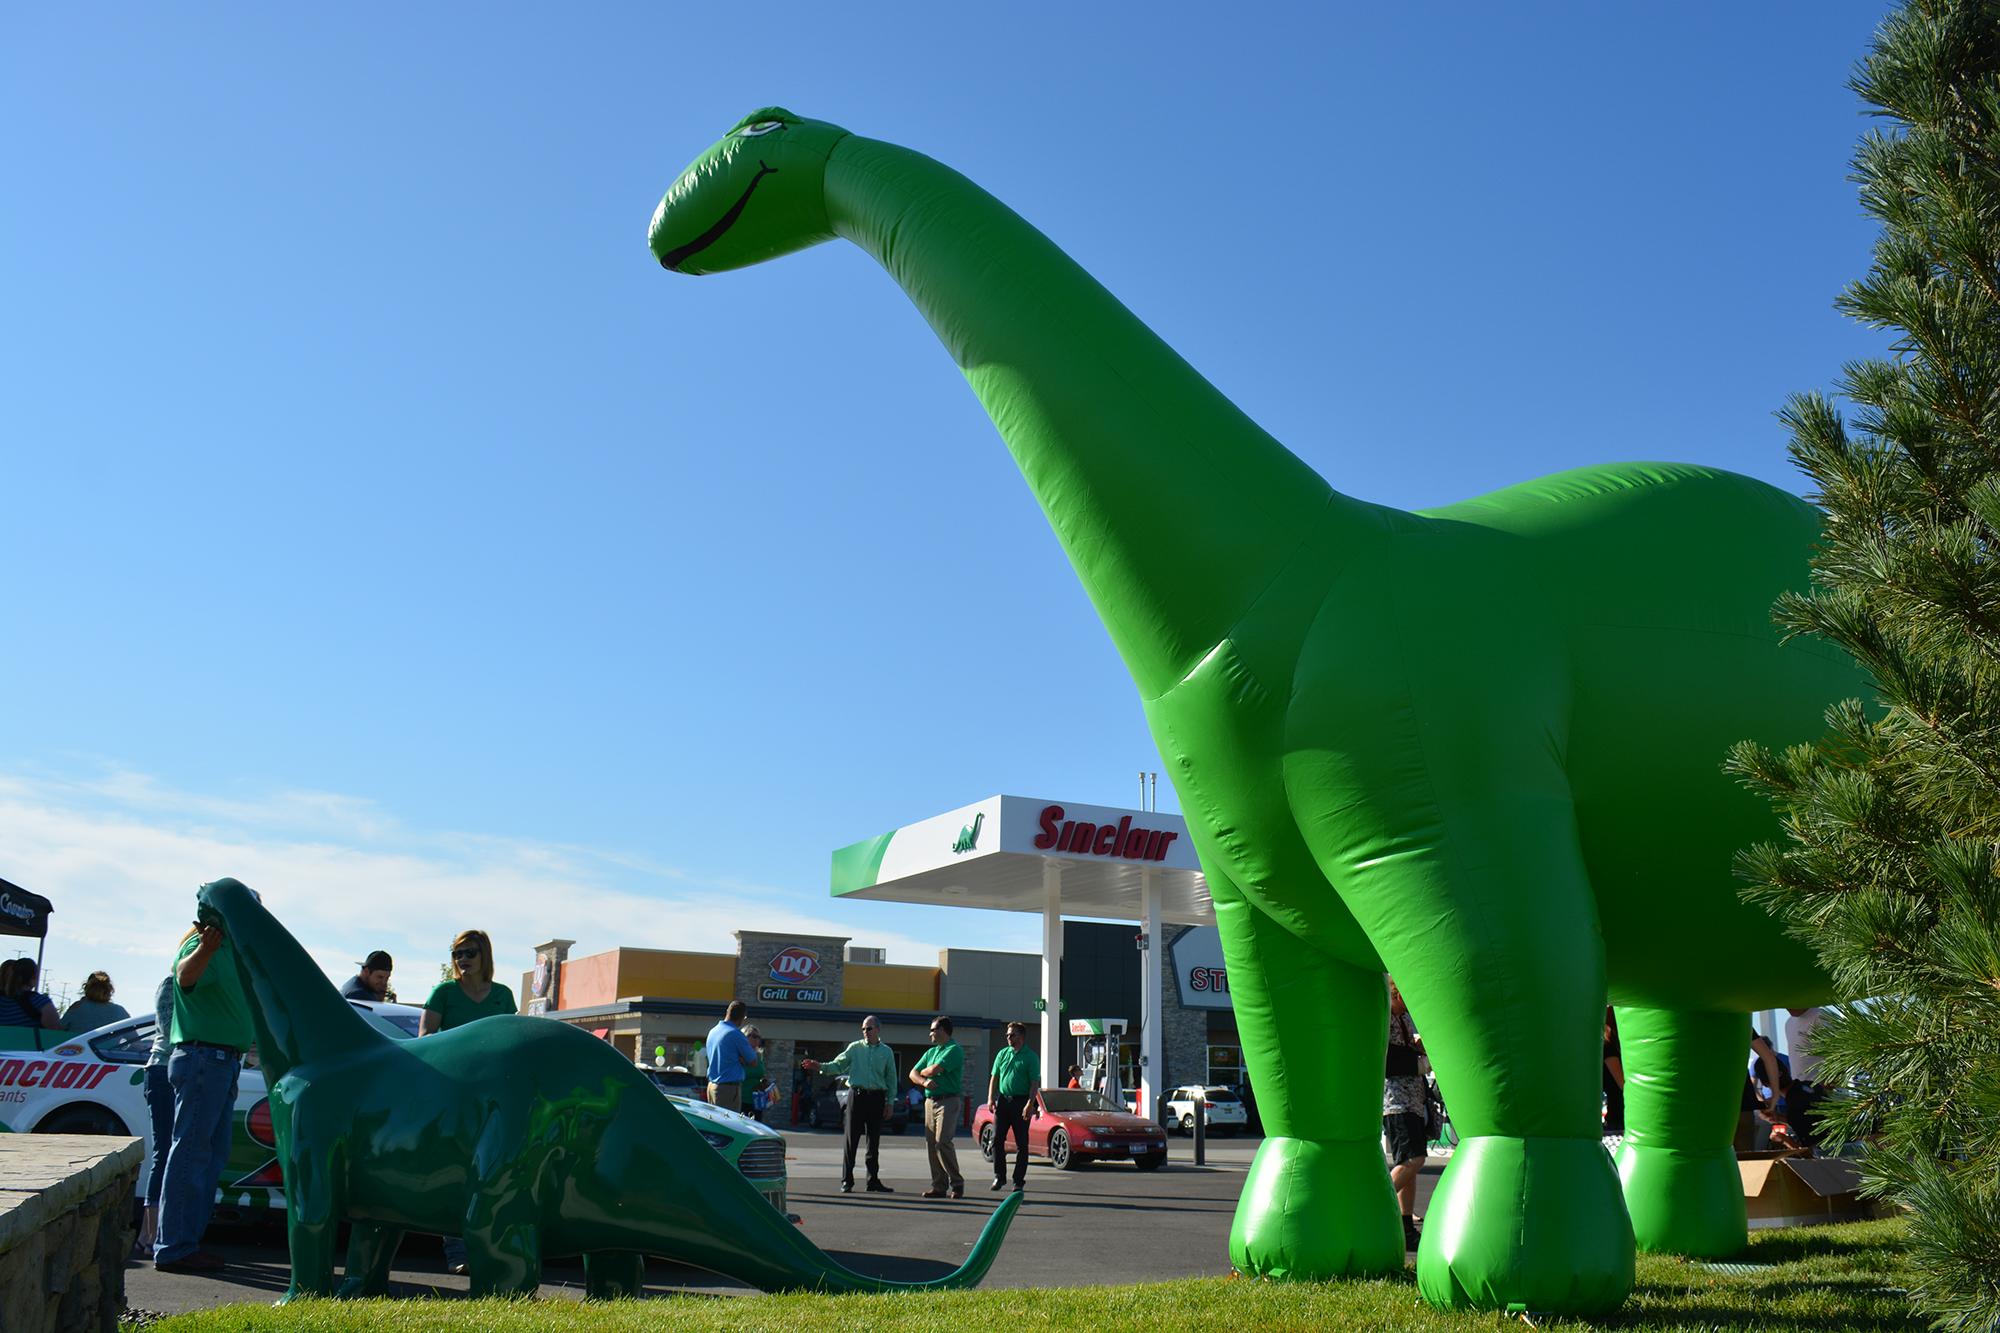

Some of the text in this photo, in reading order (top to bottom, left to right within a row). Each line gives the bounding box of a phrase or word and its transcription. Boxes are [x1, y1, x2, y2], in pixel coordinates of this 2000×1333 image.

[1034, 805, 1178, 861] Sinclair
[778, 956, 812, 976] DQ
[1190, 967, 1231, 993] ST
[763, 988, 788, 1000] Grill
[797, 989, 823, 1001] Chill
[1034, 1001, 1044, 1010] 10
